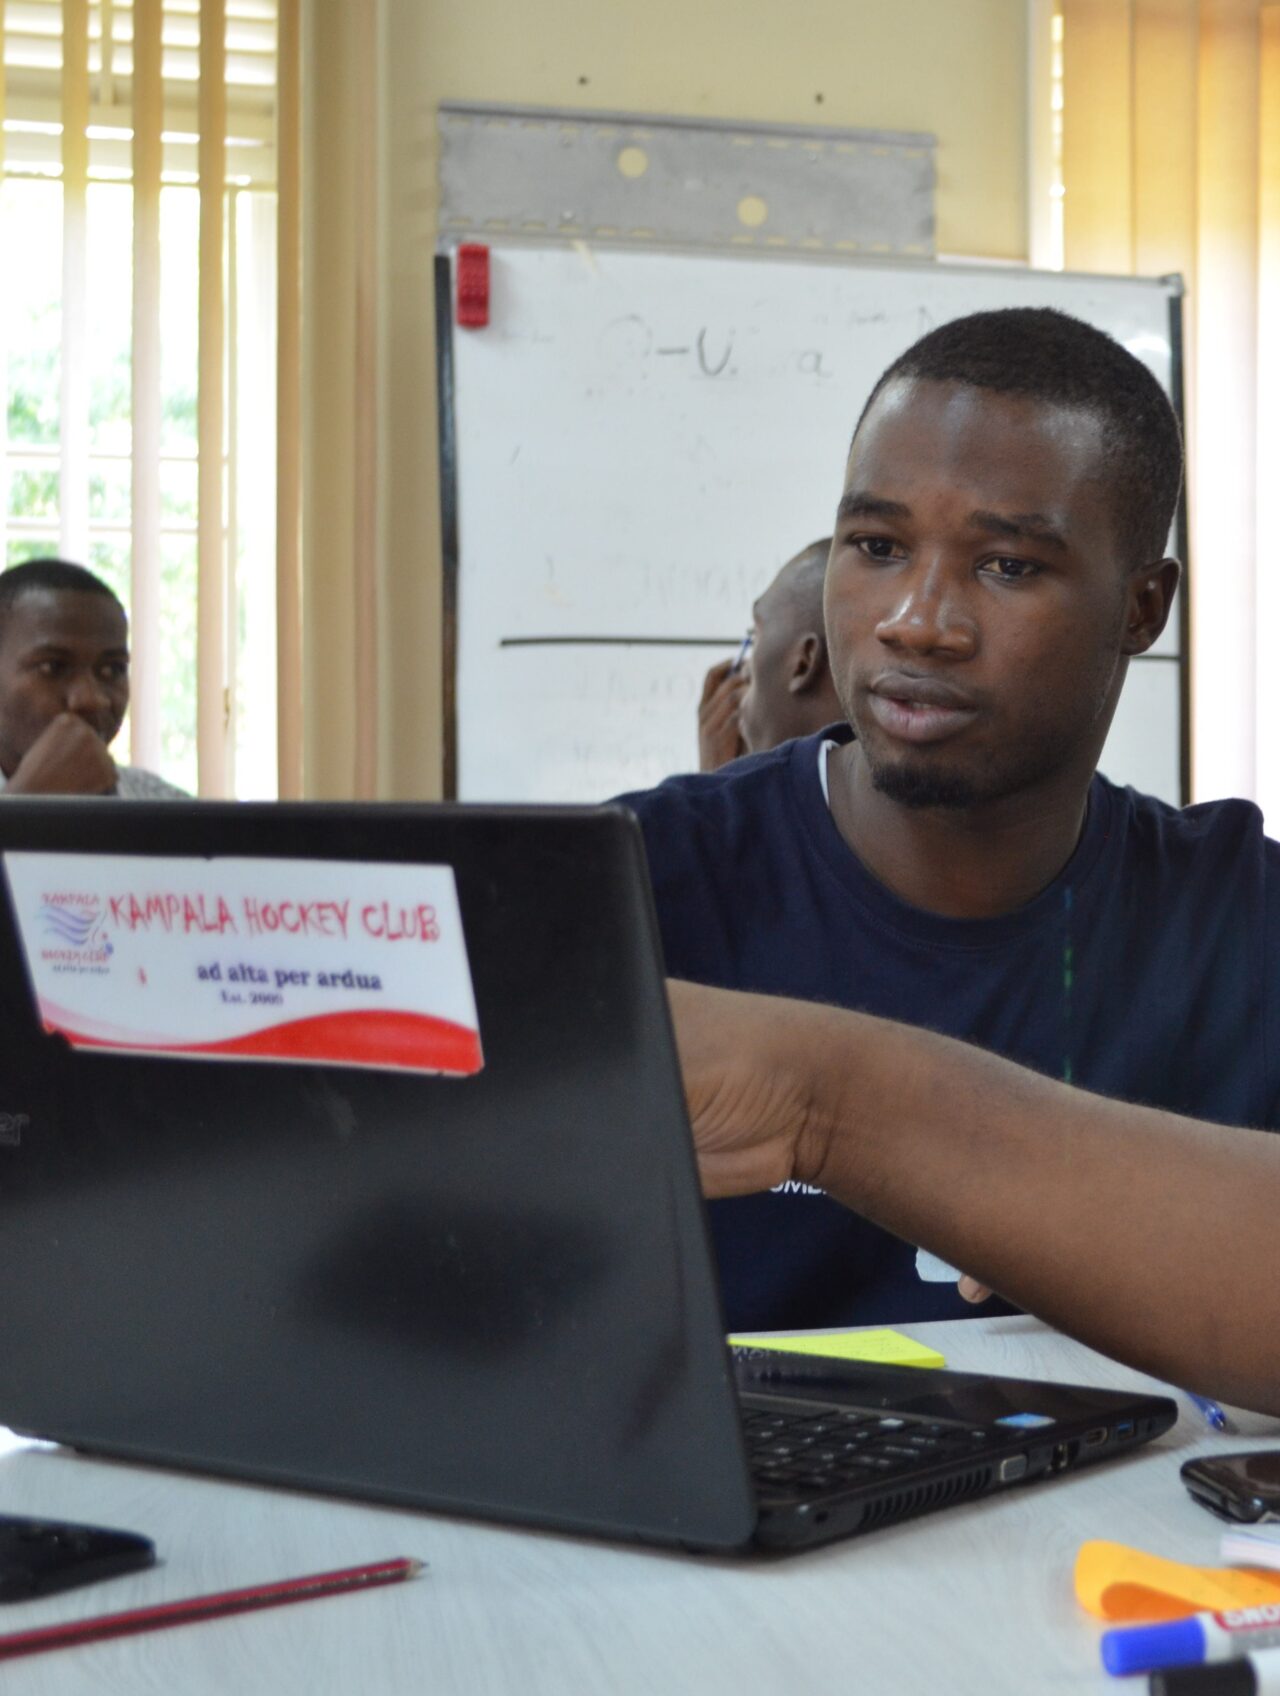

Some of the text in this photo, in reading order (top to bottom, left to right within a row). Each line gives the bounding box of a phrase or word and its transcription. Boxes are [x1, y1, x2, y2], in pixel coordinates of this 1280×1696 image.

[108, 893, 440, 944] KAMPALA HOCKEY CLUB
[197, 963, 382, 991] ad alta per ardua
